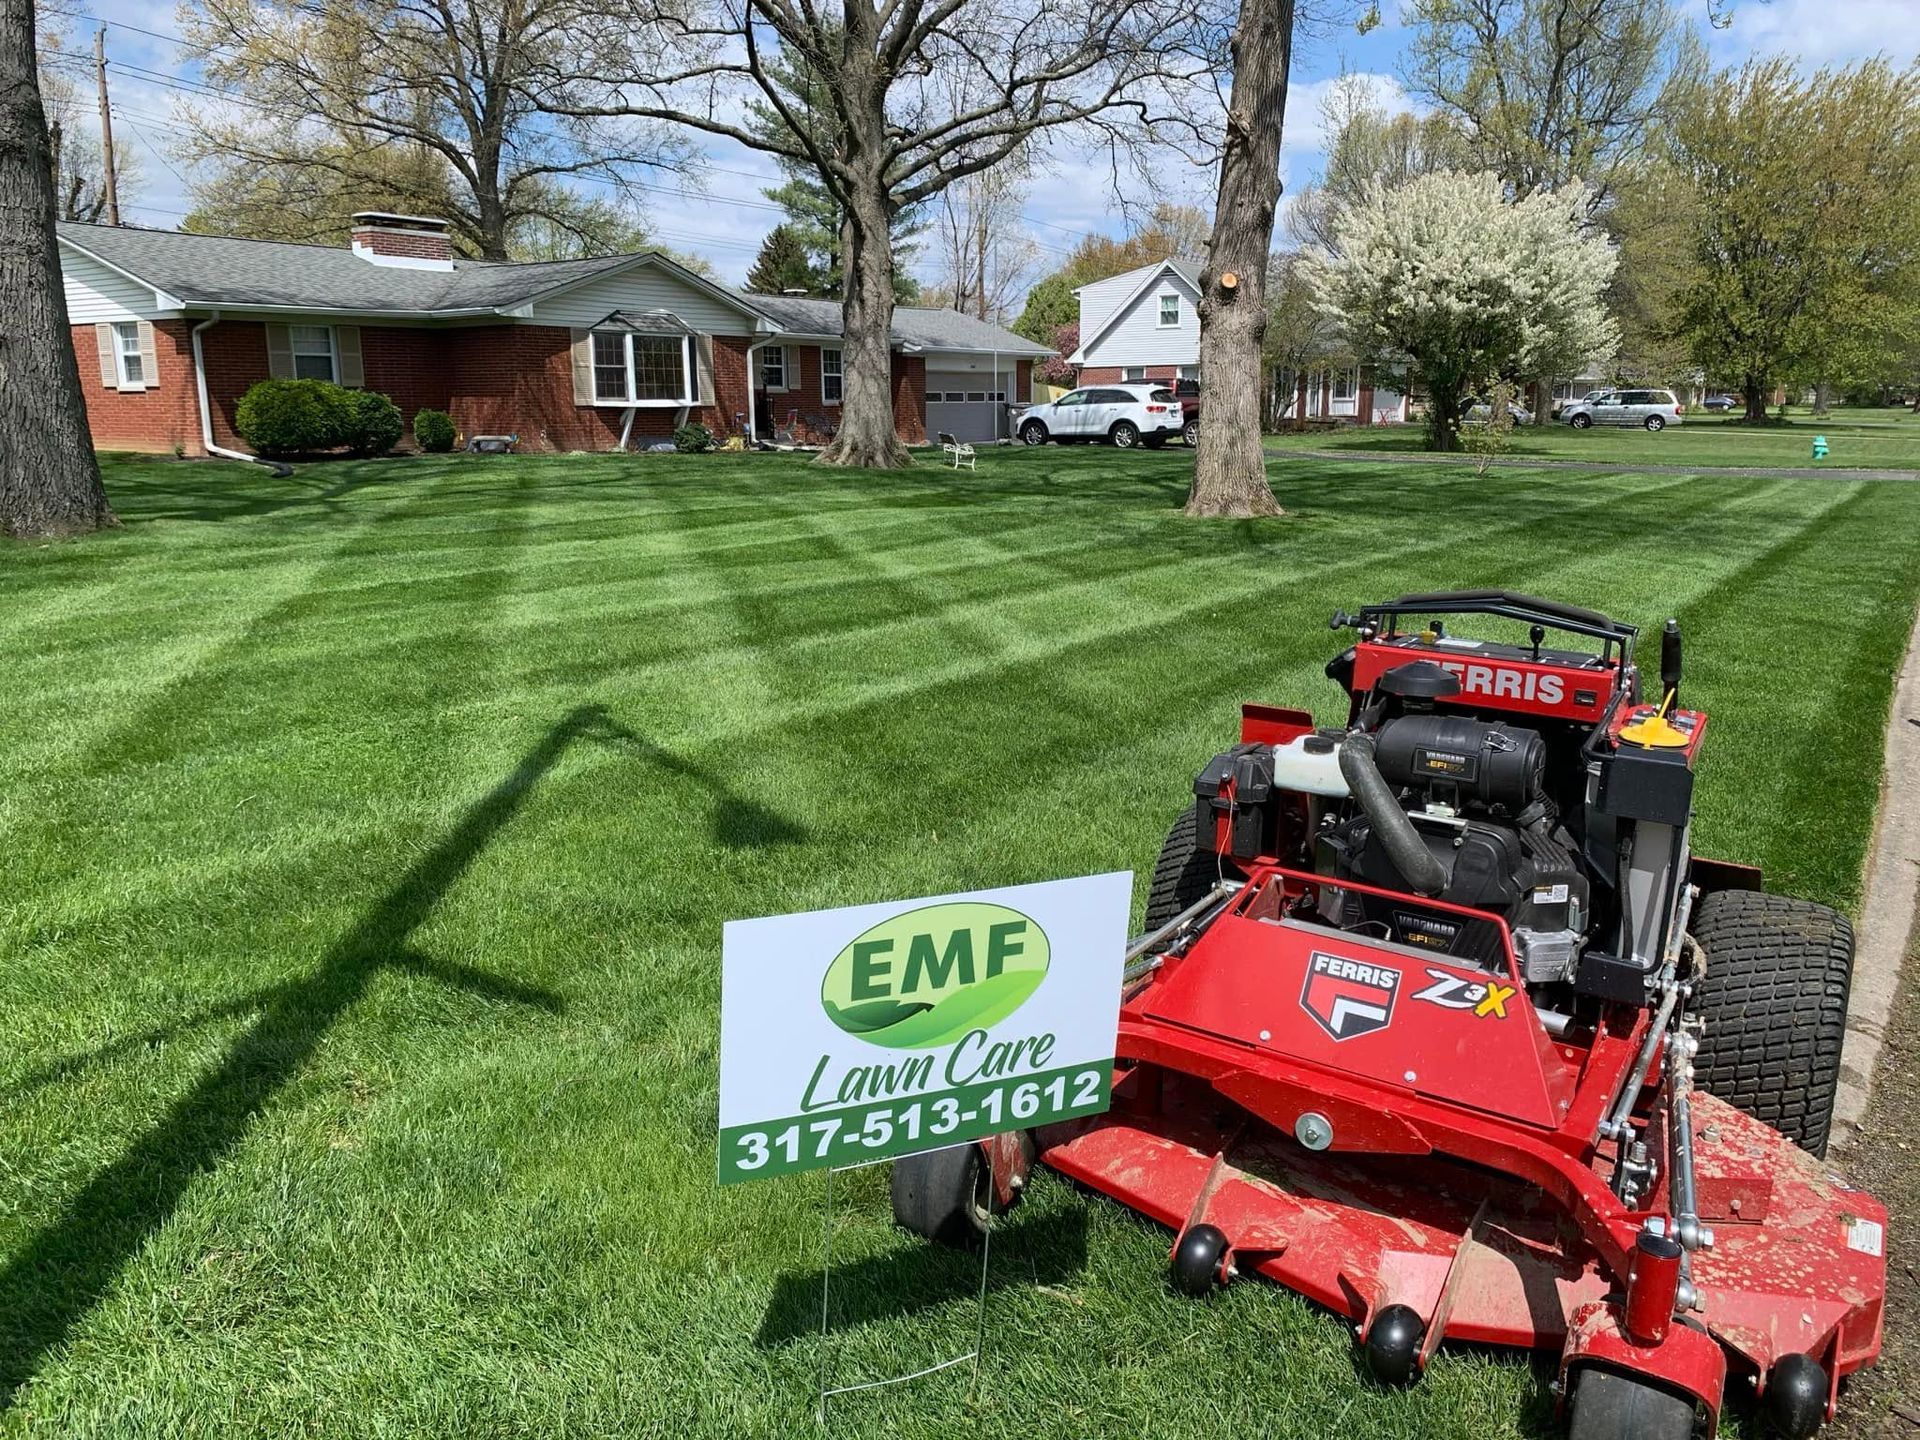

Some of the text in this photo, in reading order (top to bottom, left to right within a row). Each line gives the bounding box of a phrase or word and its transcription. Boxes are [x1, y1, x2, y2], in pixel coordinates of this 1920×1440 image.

[1418, 659, 1564, 704] RRIS
[1399, 915, 1455, 935] VANGUARD
[851, 920, 1028, 1002] EMF
[1314, 955, 1396, 989] FERRIS
[800, 1029, 1057, 1113] Lawn Care
[735, 1070, 1101, 1171] 317-513-1612
